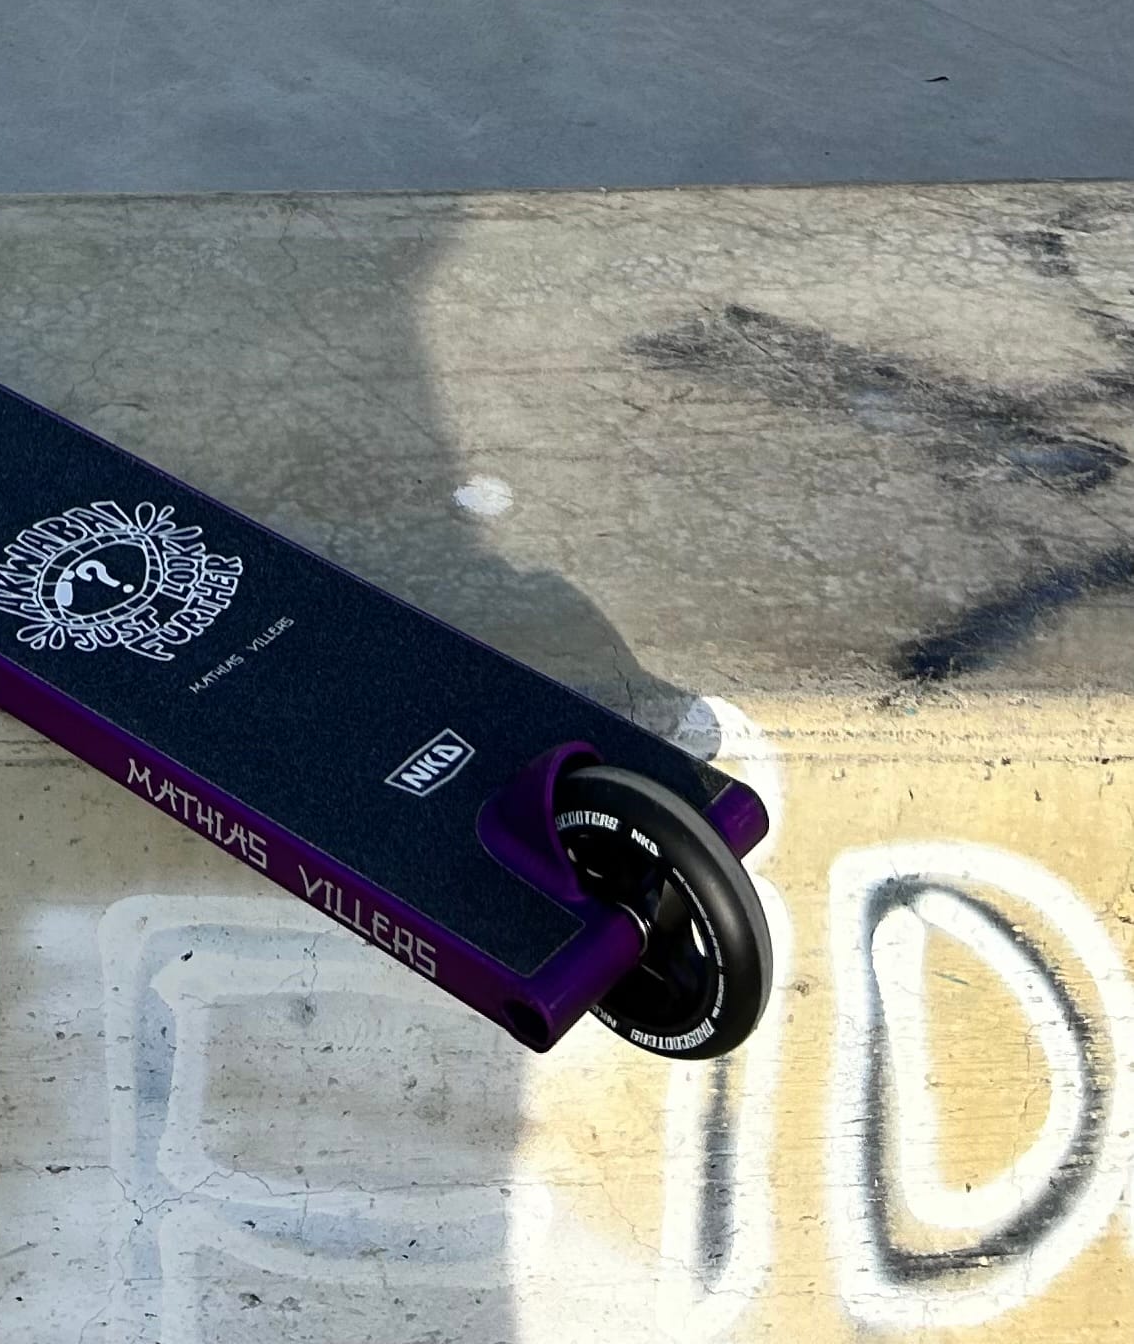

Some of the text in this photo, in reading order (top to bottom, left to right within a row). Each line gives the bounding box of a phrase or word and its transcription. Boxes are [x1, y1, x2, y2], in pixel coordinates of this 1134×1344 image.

[66, 537, 207, 652] JUST LOOK
[124, 554, 244, 662] FURTHER
[188, 616, 296, 695] MATHIAS VILLERS
[400, 743, 464, 789] NKD
[126, 758, 437, 978] MATHIAS VILLERS
[630, 827, 660, 858] NKD
